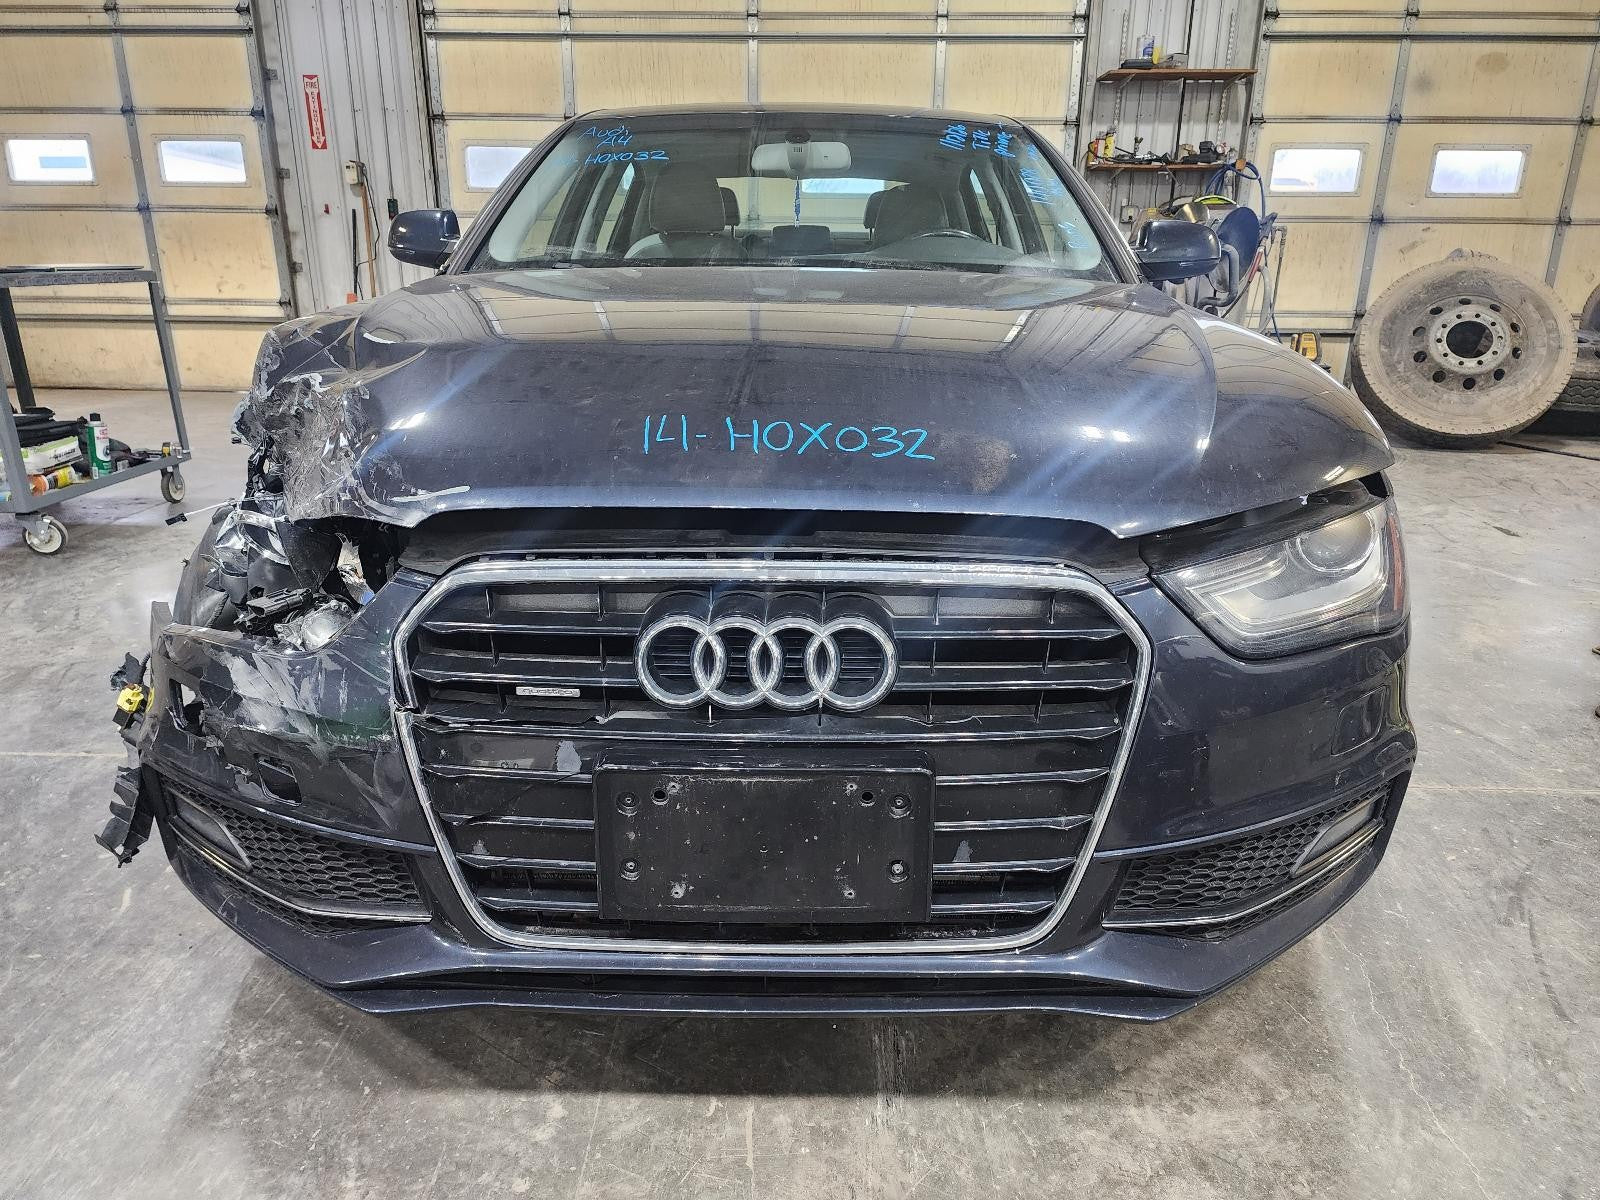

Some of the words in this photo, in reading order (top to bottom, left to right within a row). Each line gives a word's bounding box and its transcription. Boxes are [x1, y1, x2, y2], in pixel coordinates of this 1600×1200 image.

[305, 81, 318, 89] FIRE
[310, 91, 322, 144] EXTINGUISHER
[595, 134, 633, 149] A4
